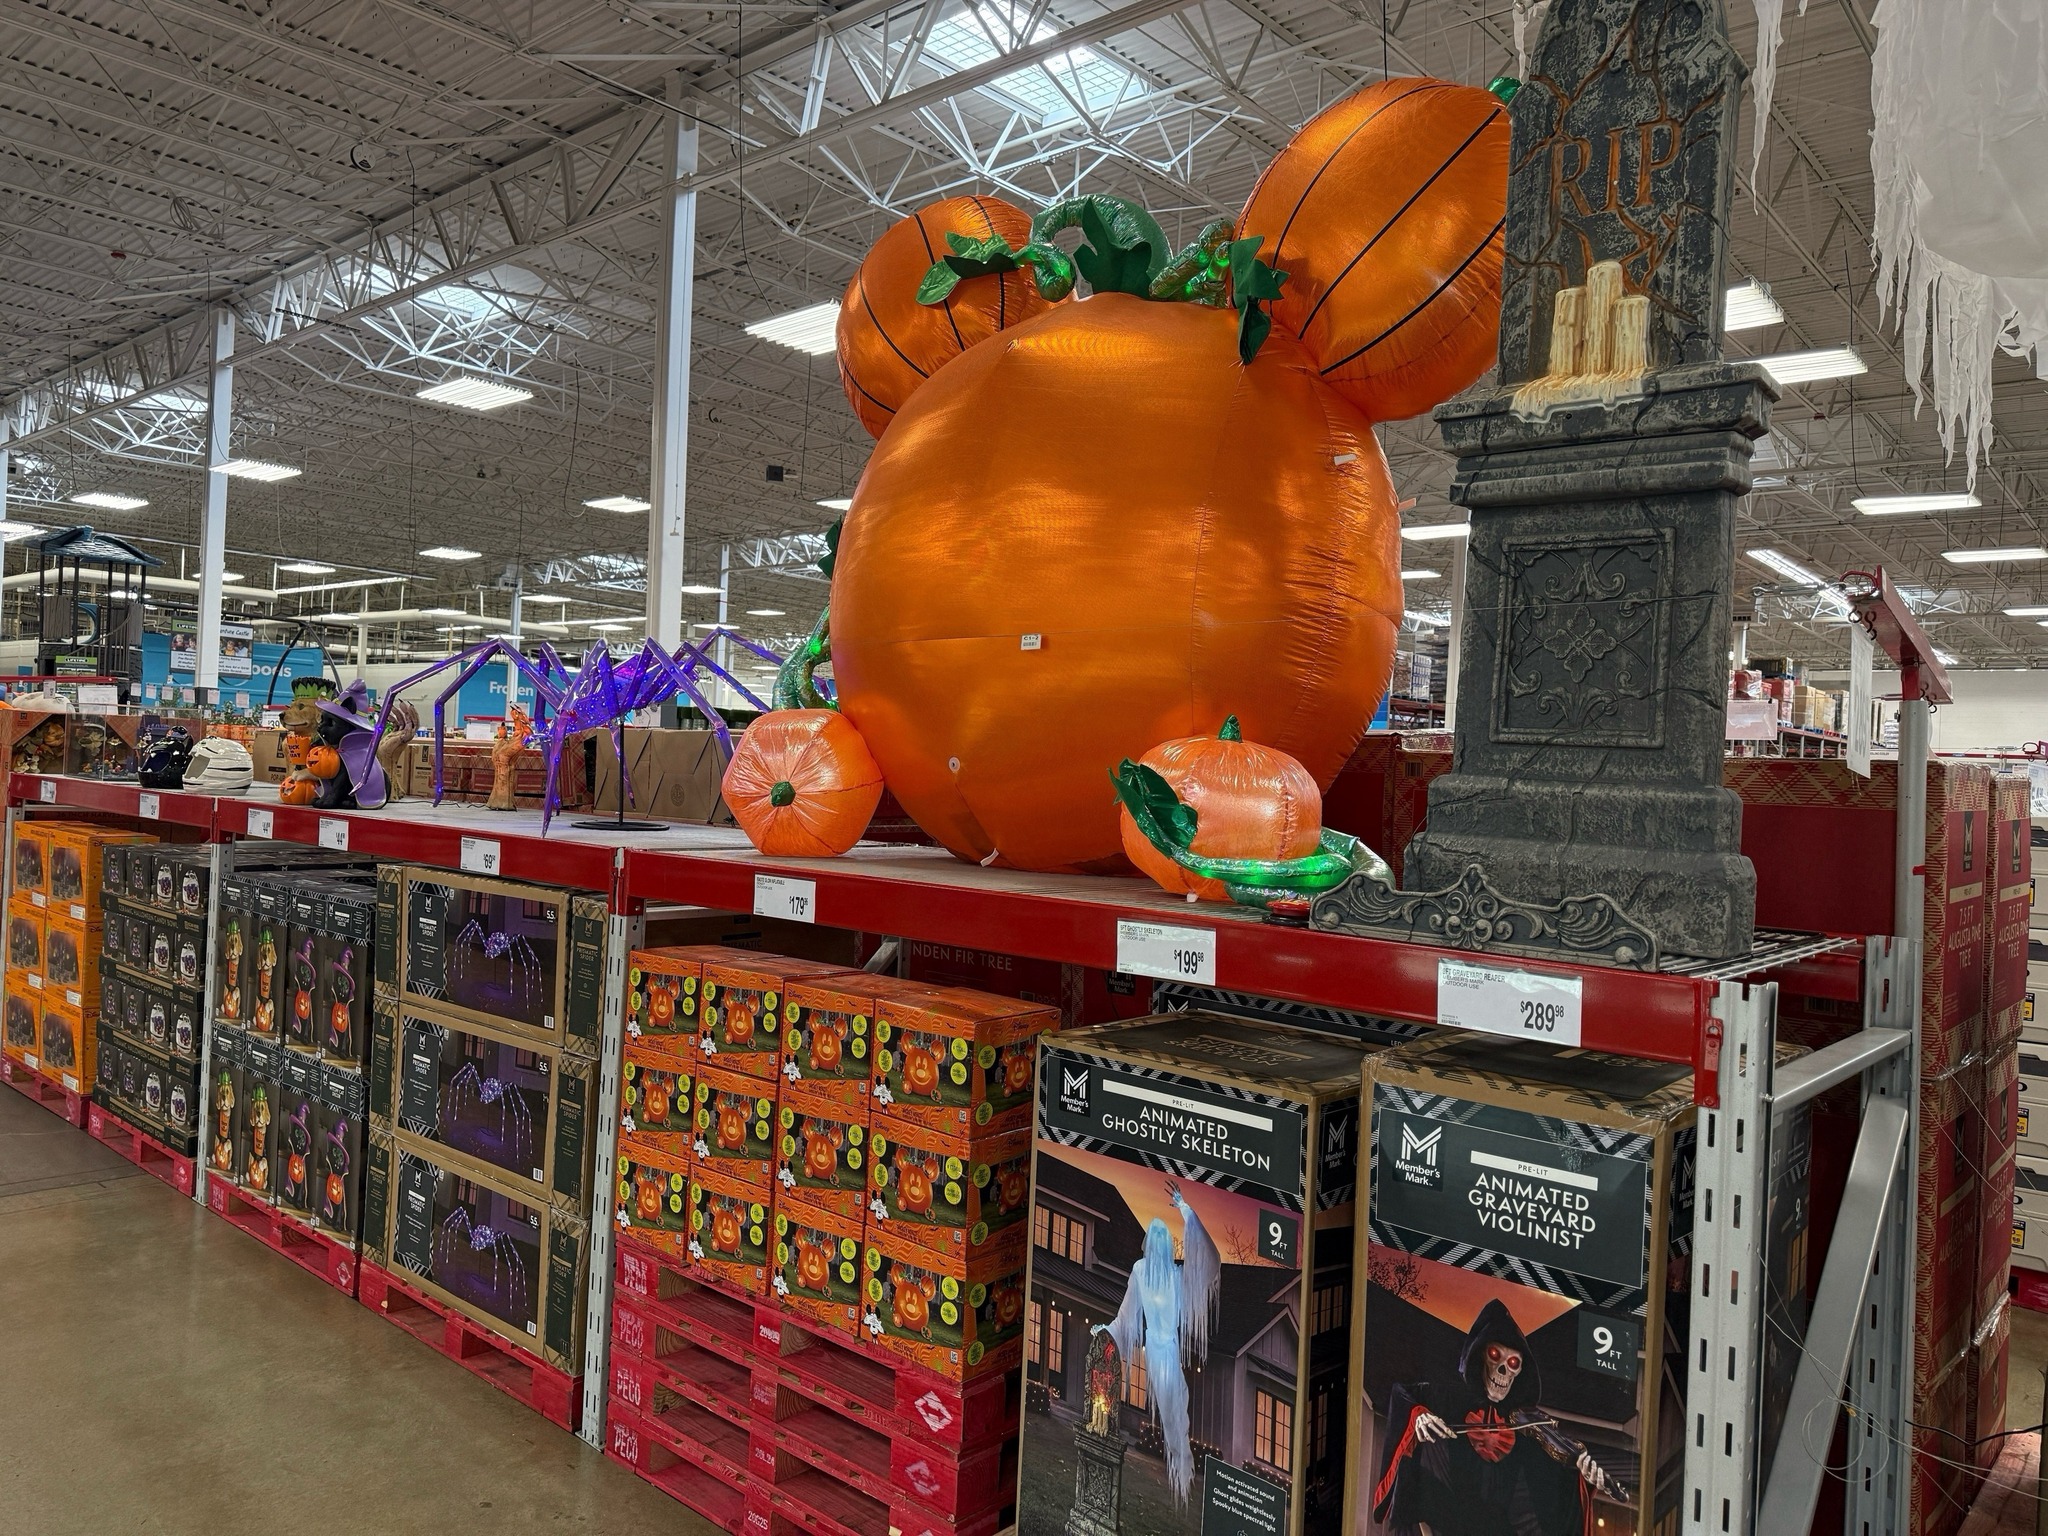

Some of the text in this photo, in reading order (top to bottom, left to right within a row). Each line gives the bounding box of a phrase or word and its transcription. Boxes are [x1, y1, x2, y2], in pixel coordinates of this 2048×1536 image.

[1551, 118, 1682, 217] RIP
[252, 662, 292, 678] oods
[489, 681, 534, 697] Froen
[913, 942, 1012, 972] NDEN FIR TREE
[1959, 950, 1971, 969] TREE
[2007, 940, 2020, 958] TREE
[1444, 980, 1468, 988] OUTDOOR
[1452, 968, 1483, 980] GRAVEYARD
[1060, 1094, 1089, 1108] Member's
[1172, 1099, 1195, 1109] PRE-LIT
[1140, 1105, 1228, 1140] ANIMATED
[1102, 1113, 1271, 1172] GHOSTLY SKELETON
[1395, 1159, 1441, 1180] Member's
[1517, 1163, 1549, 1176] PRE-LIT
[1475, 1172, 1589, 1212] ANIMATED
[1468, 1189, 1596, 1233] GRAVEYARD
[1476, 1208, 1585, 1250] VIOLINIST
[1270, 1249, 1285, 1260] TALL
[1278, 1241, 1288, 1251] FT
[620, 1317, 644, 1350] PECO
[1592, 1326, 1623, 1360] 9 FT
[1596, 1359, 1617, 1372] TALL
[616, 1379, 641, 1406] PECO
[614, 1427, 638, 1464] PECO
[1216, 1469, 1275, 1502] Motion activated sound
[1227, 1484, 1263, 1504] and animation
[1212, 1497, 1276, 1533] Spooky blue spectral light
[1213, 1487, 1276, 1522] Ghost glides weightlessly
